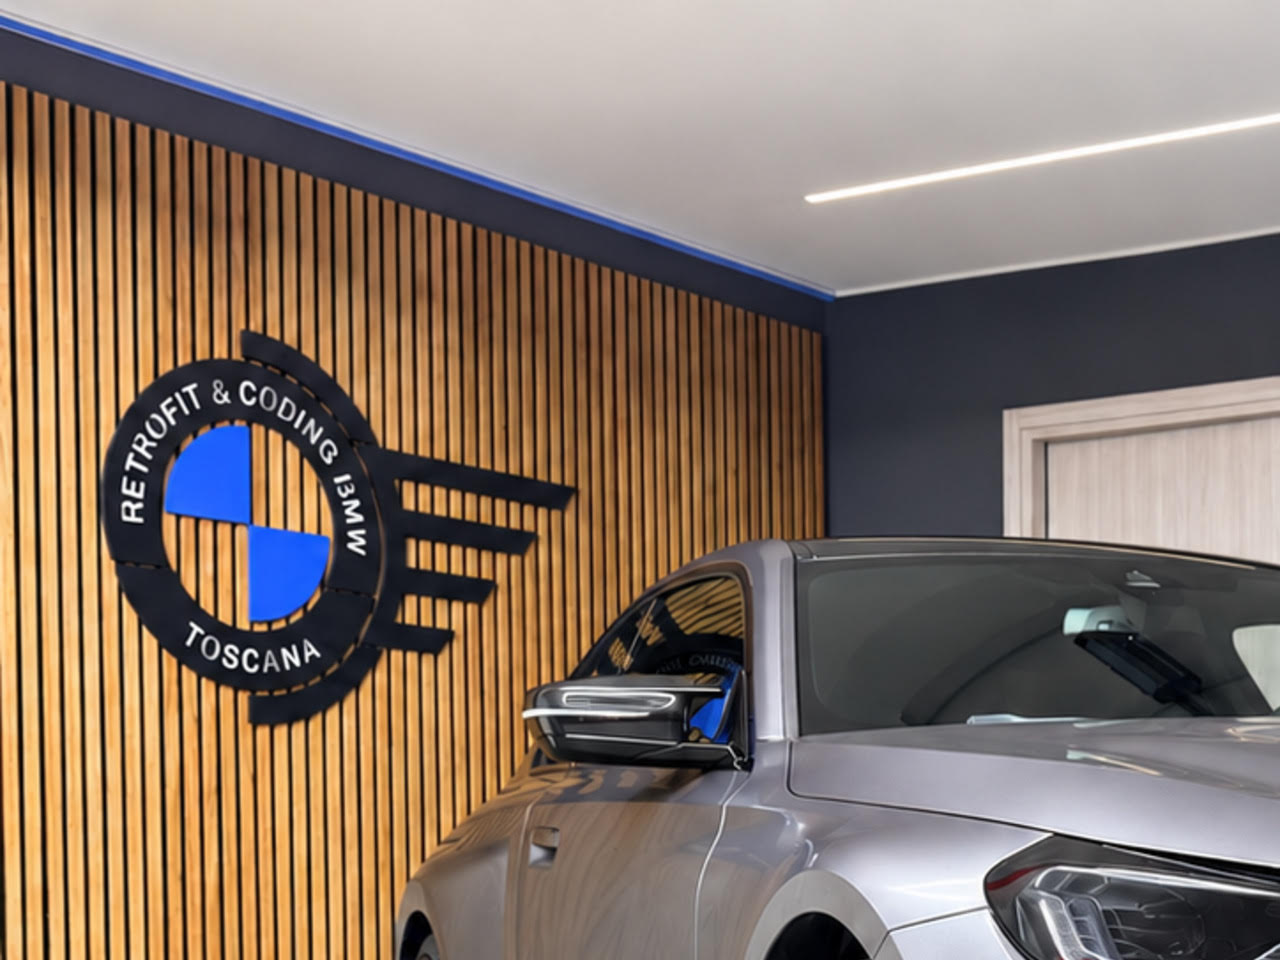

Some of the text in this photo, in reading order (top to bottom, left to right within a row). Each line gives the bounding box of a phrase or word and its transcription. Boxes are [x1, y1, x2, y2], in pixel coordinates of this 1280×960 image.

[120, 382, 201, 524] RETROFIT
[212, 379, 231, 405] &
[239, 380, 339, 465] CODING
[185, 621, 322, 674] TOSCANA
